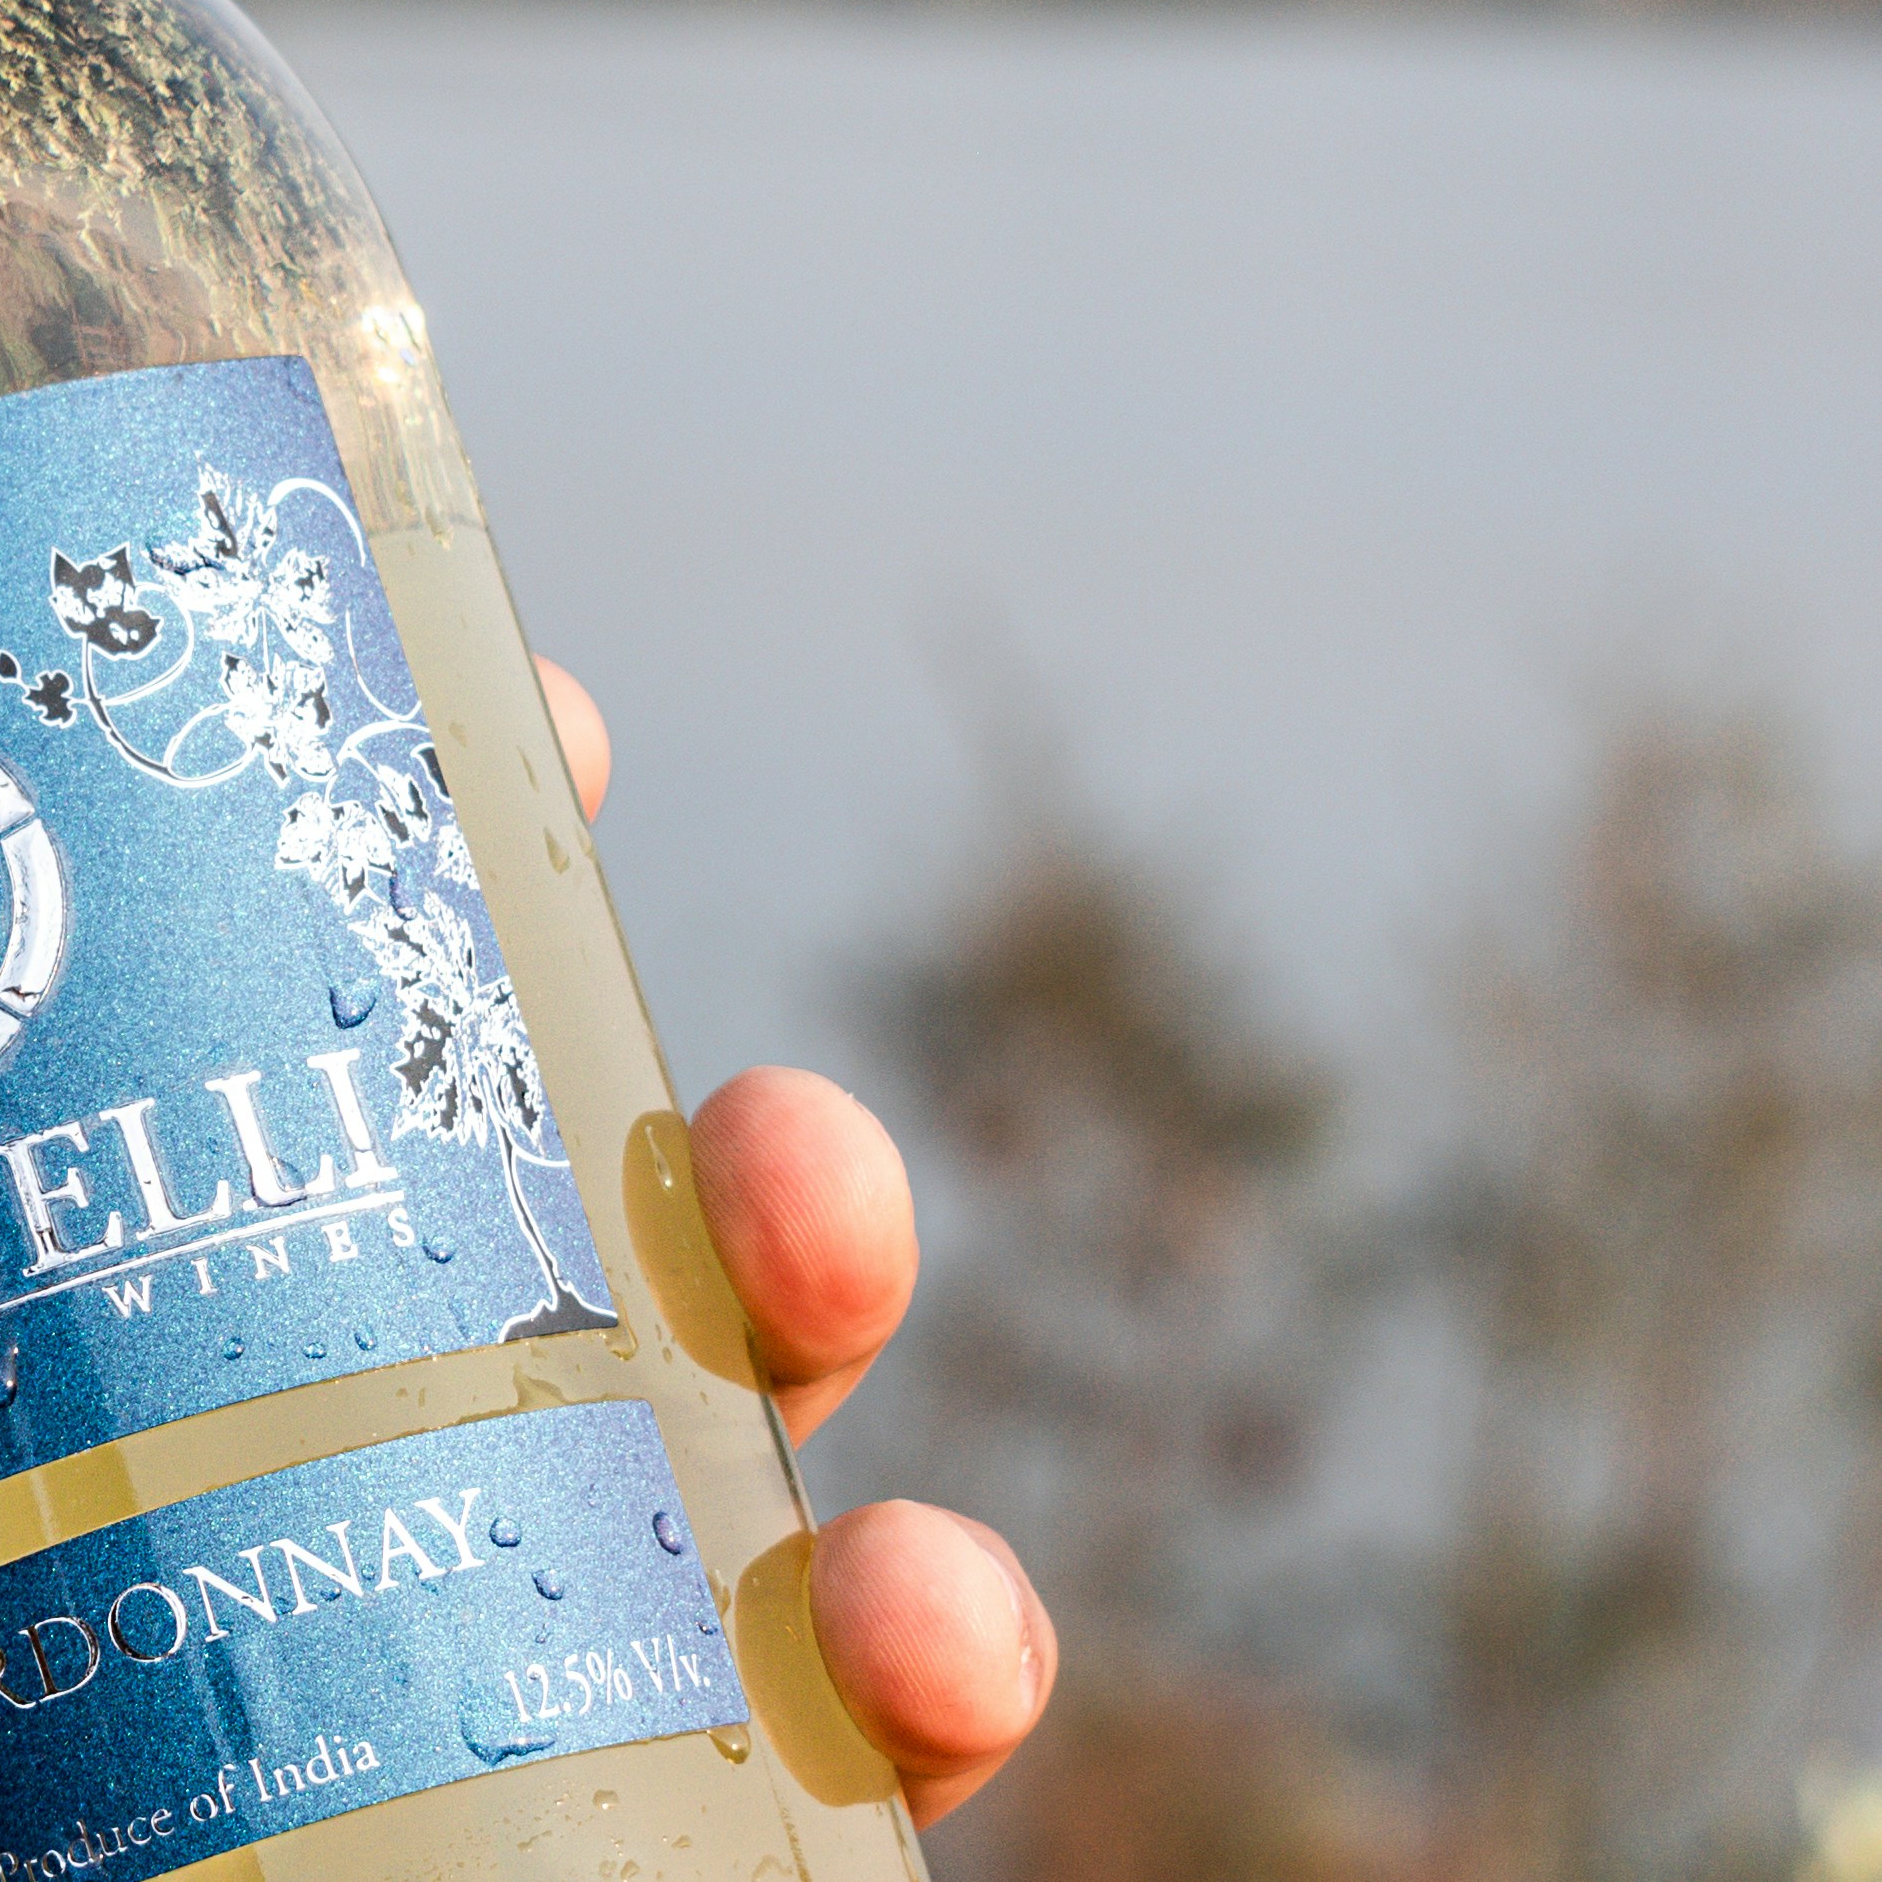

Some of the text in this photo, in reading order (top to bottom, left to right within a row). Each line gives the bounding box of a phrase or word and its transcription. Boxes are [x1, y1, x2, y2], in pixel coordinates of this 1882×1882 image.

[102, 1208, 415, 1318] WINES
[504, 1648, 633, 1722] 12.5%
[189, 1764, 246, 1822] of
[248, 1734, 380, 1802] India
